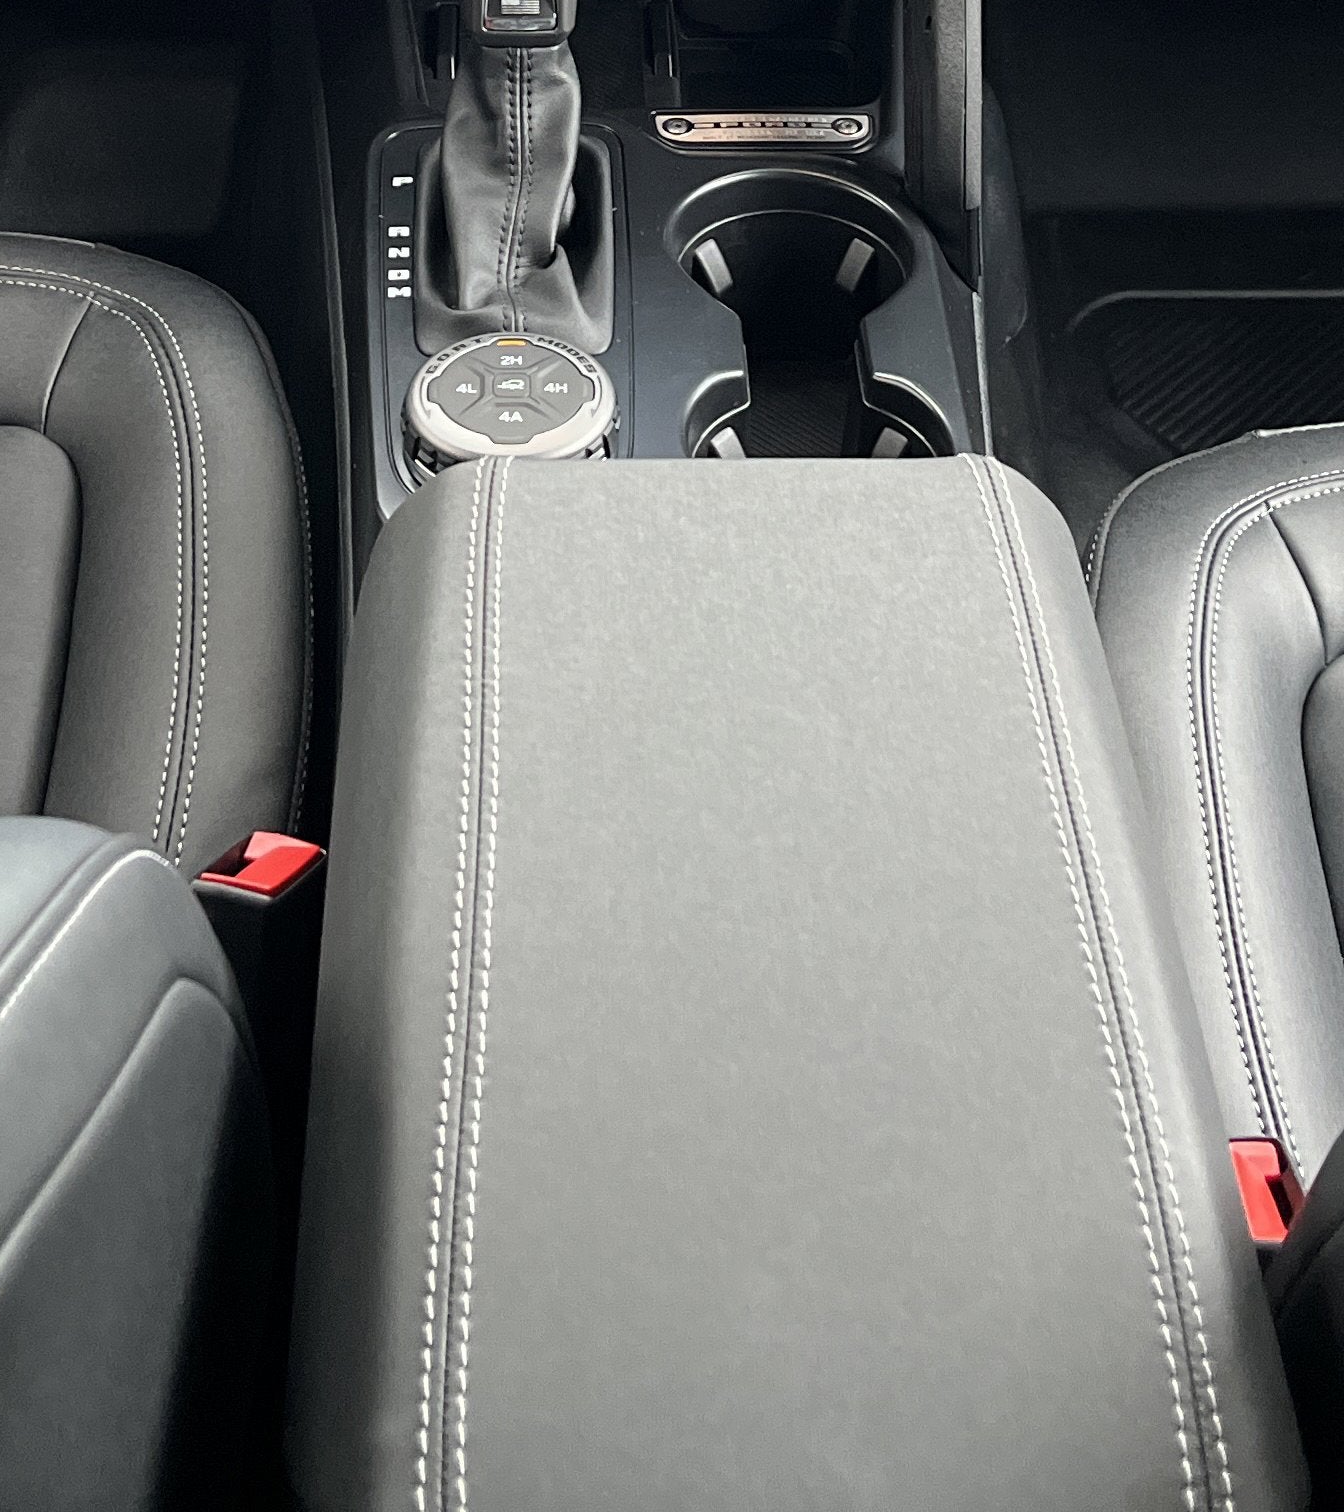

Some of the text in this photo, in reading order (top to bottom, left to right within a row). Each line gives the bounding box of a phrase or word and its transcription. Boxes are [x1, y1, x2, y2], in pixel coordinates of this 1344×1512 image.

[392, 176, 413, 187] P
[388, 247, 410, 258] N
[388, 269, 410, 281] D
[387, 286, 411, 298] M
[500, 355, 523, 366] 2H
[537, 337, 599, 374] MODES
[455, 382, 477, 394] 4L
[544, 382, 568, 394] 4H
[499, 410, 523, 422] 4A
